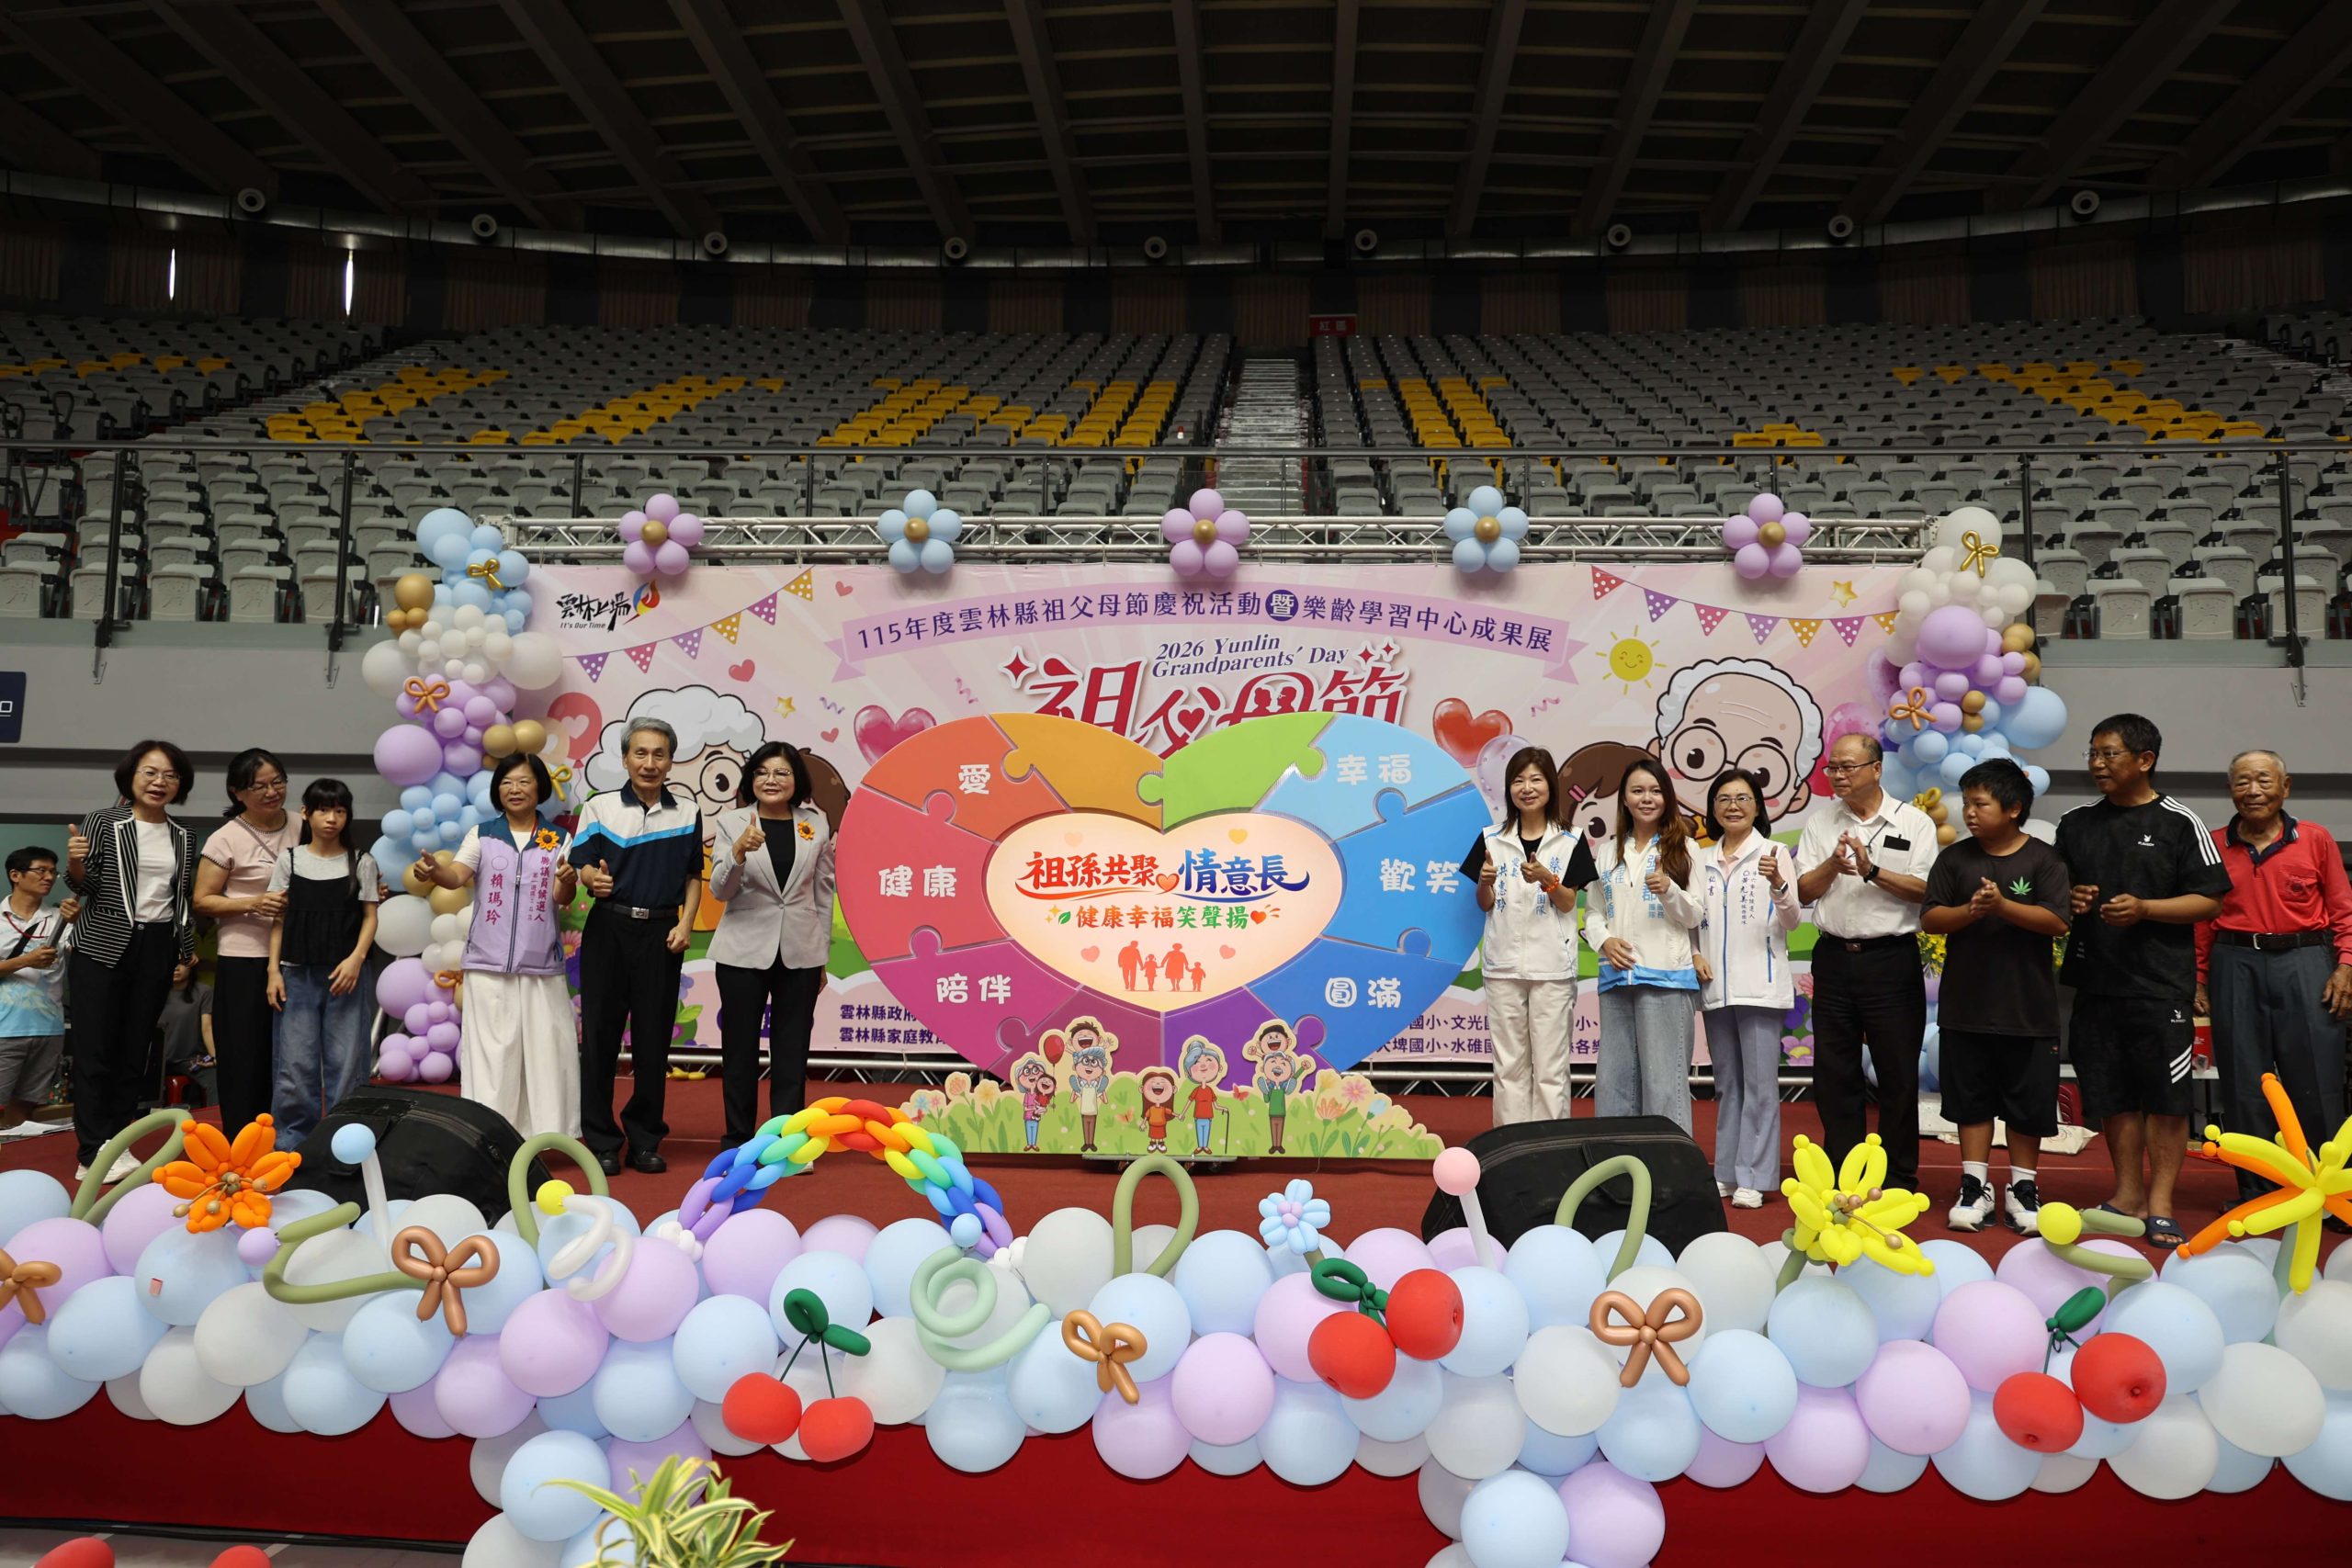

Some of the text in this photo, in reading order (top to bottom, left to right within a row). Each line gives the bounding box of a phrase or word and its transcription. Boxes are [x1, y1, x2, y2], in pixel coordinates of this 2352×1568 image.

[556, 592, 632, 633] 雲林上場
[857, 590, 1553, 653] 115年度雲林縣祖父母節慶祝活動暨樂齡學習中心成果展
[1155, 634, 1282, 661] 2026 Yunlin
[1308, 647, 1350, 668] Day
[957, 763, 991, 795] 愛
[1337, 753, 1412, 785] 幸福
[878, 864, 957, 897] 健康
[1015, 847, 1310, 897] 祖孫共聚 情意長
[1379, 858, 1460, 894] 歡笑
[485, 874, 503, 925] 賴瑪玲
[1075, 904, 1250, 930] 健康幸福笑聲揚
[935, 973, 1012, 1005] 陪伴
[1325, 976, 1402, 1009] 圓滿
[839, 1027, 945, 1044] 雲林縣家庭教
